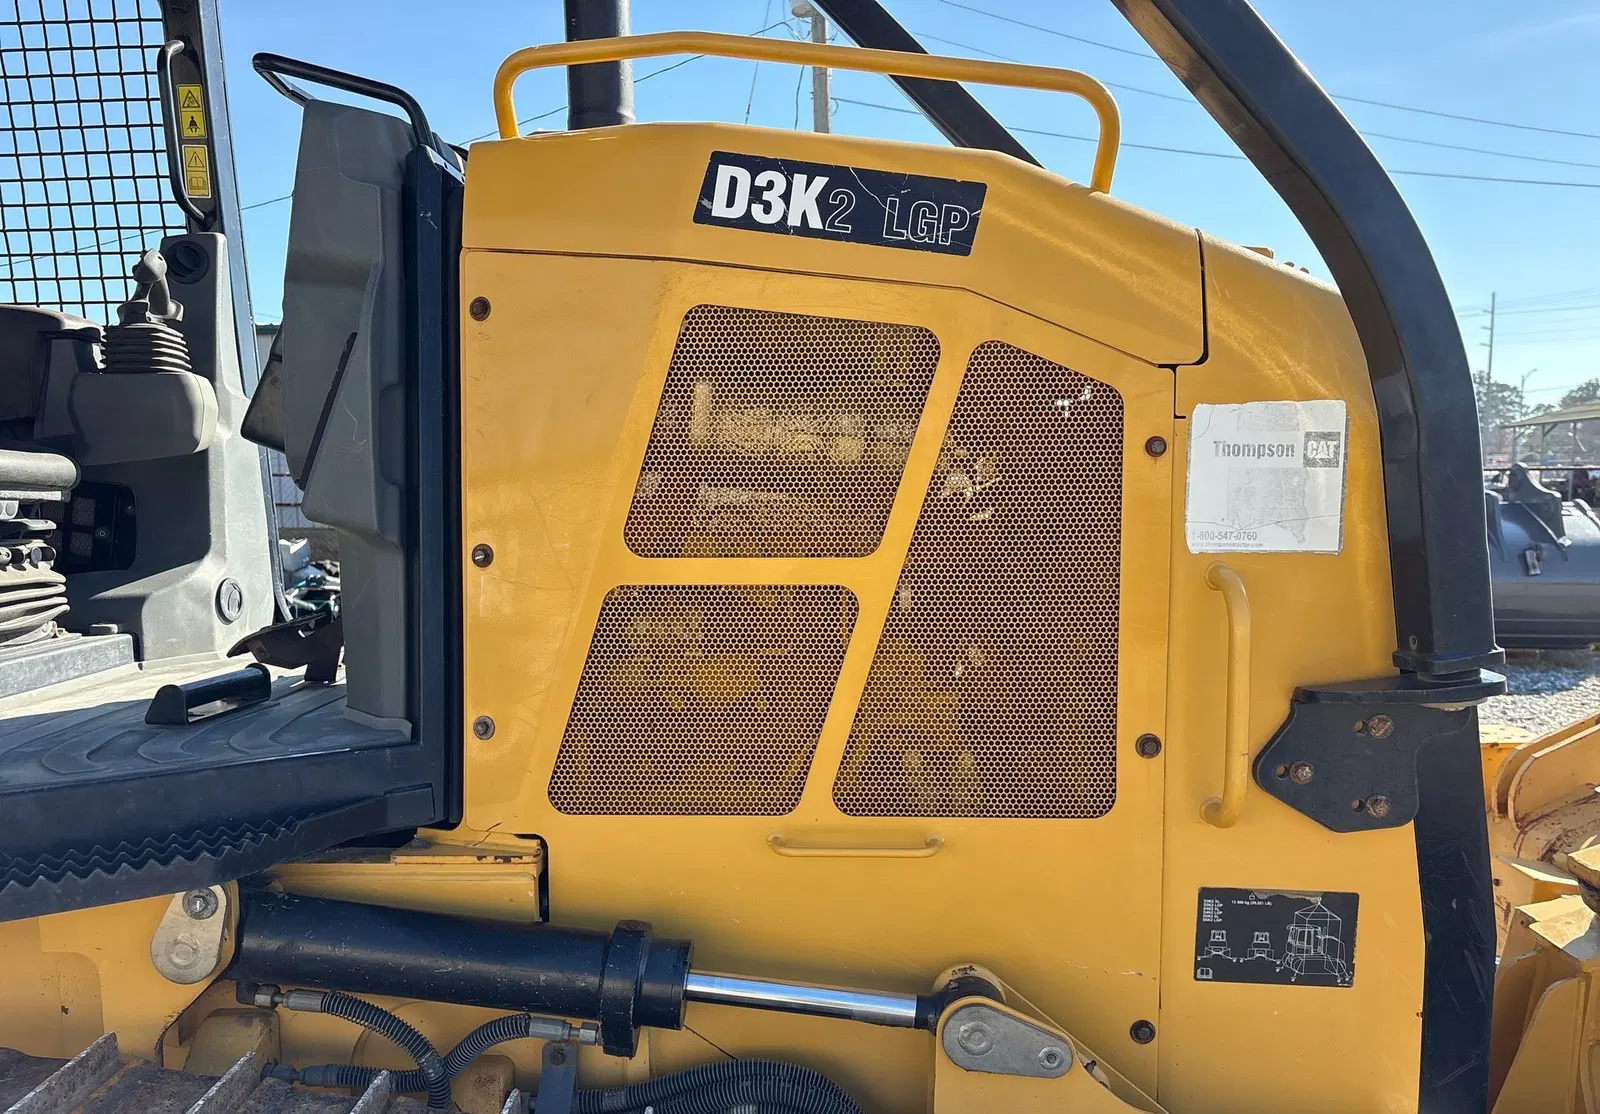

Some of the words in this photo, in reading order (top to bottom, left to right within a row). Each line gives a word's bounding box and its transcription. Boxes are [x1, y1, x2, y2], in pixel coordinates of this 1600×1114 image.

[711, 164, 856, 233] D3K2
[883, 197, 970, 245] LGP
[1213, 440, 1296, 460] Thompson
[1307, 440, 1339, 459] CAT
[1191, 531, 1258, 541] 1-800-547-0760
